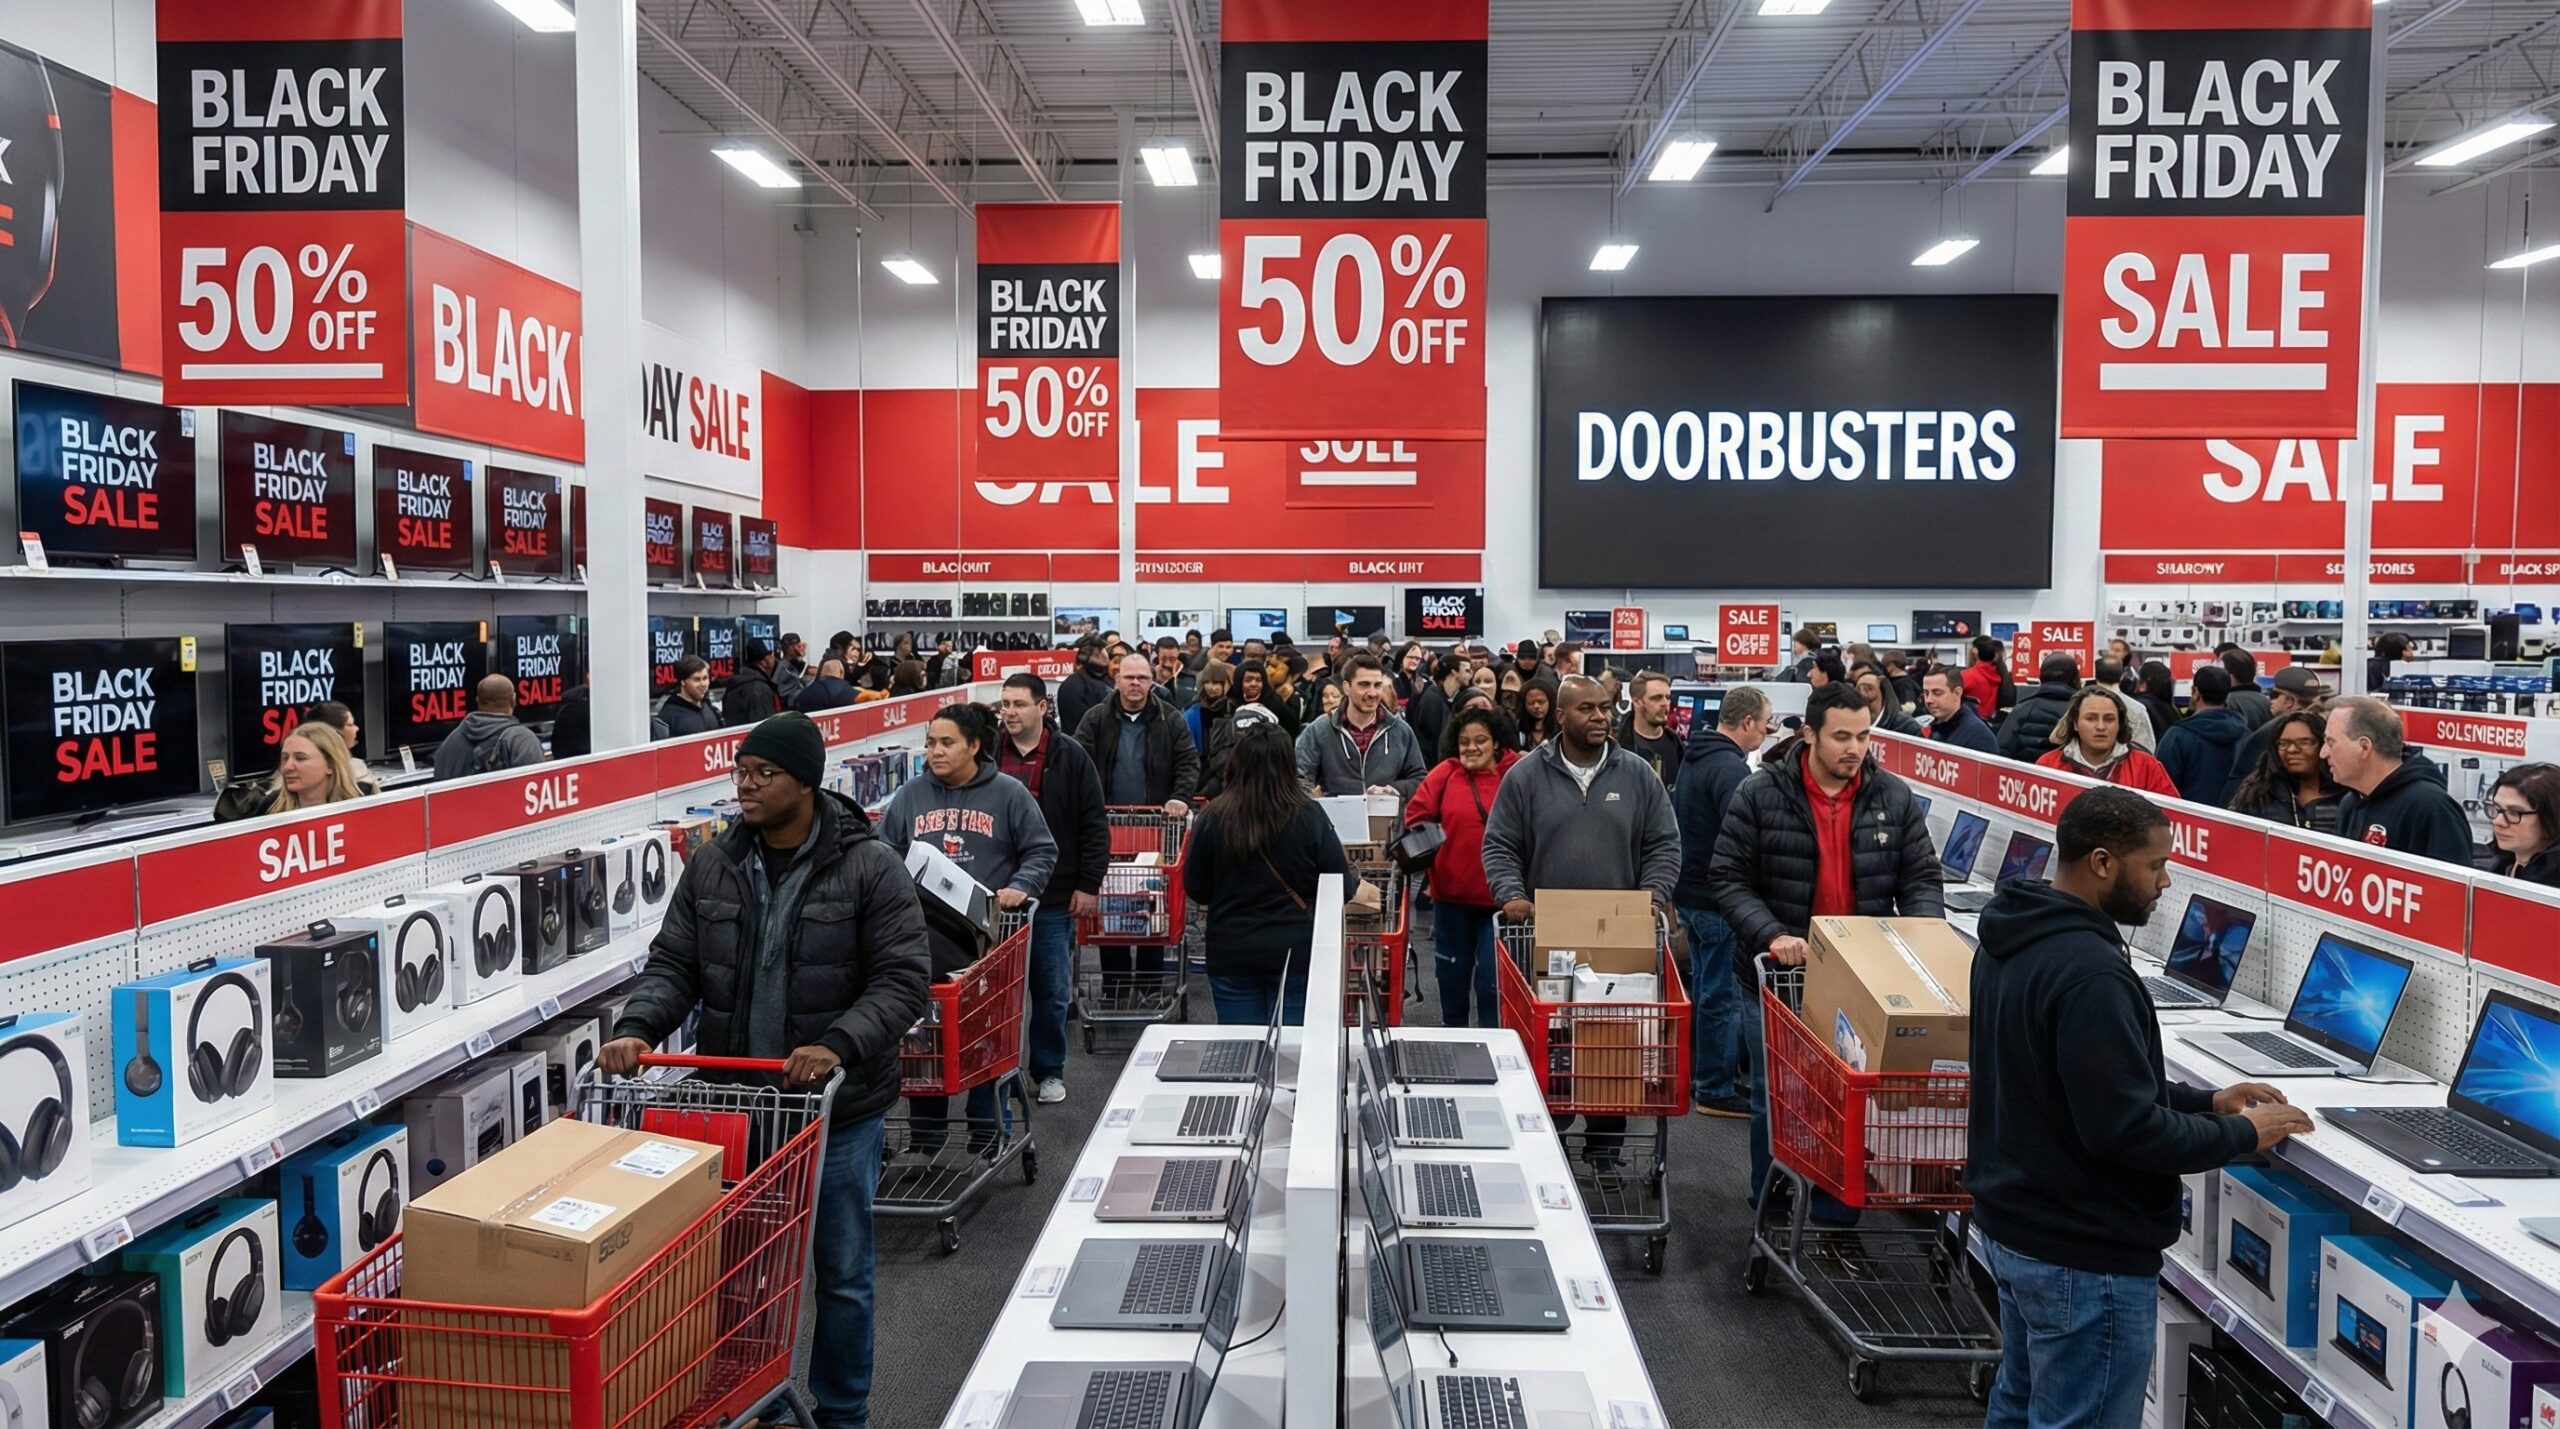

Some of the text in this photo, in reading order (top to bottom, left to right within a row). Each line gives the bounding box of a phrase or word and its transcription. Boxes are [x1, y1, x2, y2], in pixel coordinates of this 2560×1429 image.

[191, 67, 388, 129] BLACK
[1245, 70, 1463, 133] BLACK
[2098, 60, 2341, 126] BLACK
[192, 134, 390, 195] FRIDAY
[1245, 141, 1465, 201] FRIDAY
[2095, 134, 2341, 198] FRIDAY
[178, 243, 367, 352] 50%
[990, 280, 1107, 313] BLACK
[1240, 233, 1466, 366] 50%
[2101, 252, 2330, 349] SALE
[308, 310, 376, 350] OFF
[990, 317, 1108, 350] FRIDAY
[1388, 317, 1464, 365] OFF
[433, 283, 572, 416] BLACK
[689, 376, 751, 461] SALE
[985, 366, 1108, 438] 50%
[61, 417, 158, 459] BLACK
[1067, 412, 1109, 438] OFF
[254, 443, 326, 477] BLACK
[1577, 410, 2017, 482] DOORBUSTERS
[63, 452, 157, 489] FRIDAY
[398, 469, 450, 498] BLACK
[255, 473, 327, 503] FRIDAY
[504, 487, 547, 511] BLACK
[63, 486, 159, 530] SALE
[255, 502, 328, 539] SALE
[398, 494, 451, 519] FRIDAY
[504, 509, 547, 532] FRIDAY
[398, 518, 451, 549] SALE
[504, 530, 547, 556] SALE
[647, 544, 674, 564] SALE
[1349, 561, 1396, 574] BLACK
[1422, 596, 1466, 607] BLACK
[1728, 610, 1769, 625] SALE
[1422, 617, 1466, 629] SALE
[2042, 627, 2084, 642] SALE
[410, 642, 465, 666] BLACK
[517, 634, 559, 655] BLACK
[260, 648, 335, 677] BLACK
[410, 666, 466, 691] FRIDAY
[517, 656, 561, 678] FRIDAY
[656, 664, 677, 685] SAL
[53, 668, 154, 702] BLACK
[261, 677, 335, 706] FRIDAY
[518, 677, 562, 707] SALE
[54, 701, 156, 737] FRIDAY
[412, 690, 467, 723] SALE
[883, 704, 907, 727] SALE
[262, 707, 299, 745] SA
[56, 733, 157, 783] SALE
[1938, 761, 1960, 787] OFF
[525, 773, 579, 816] SALE
[1998, 775, 2058, 817] 50% OFF
[259, 824, 346, 883] SALE
[2169, 821, 2209, 863] ALE
[2298, 854, 2423, 924] 50% OFF
